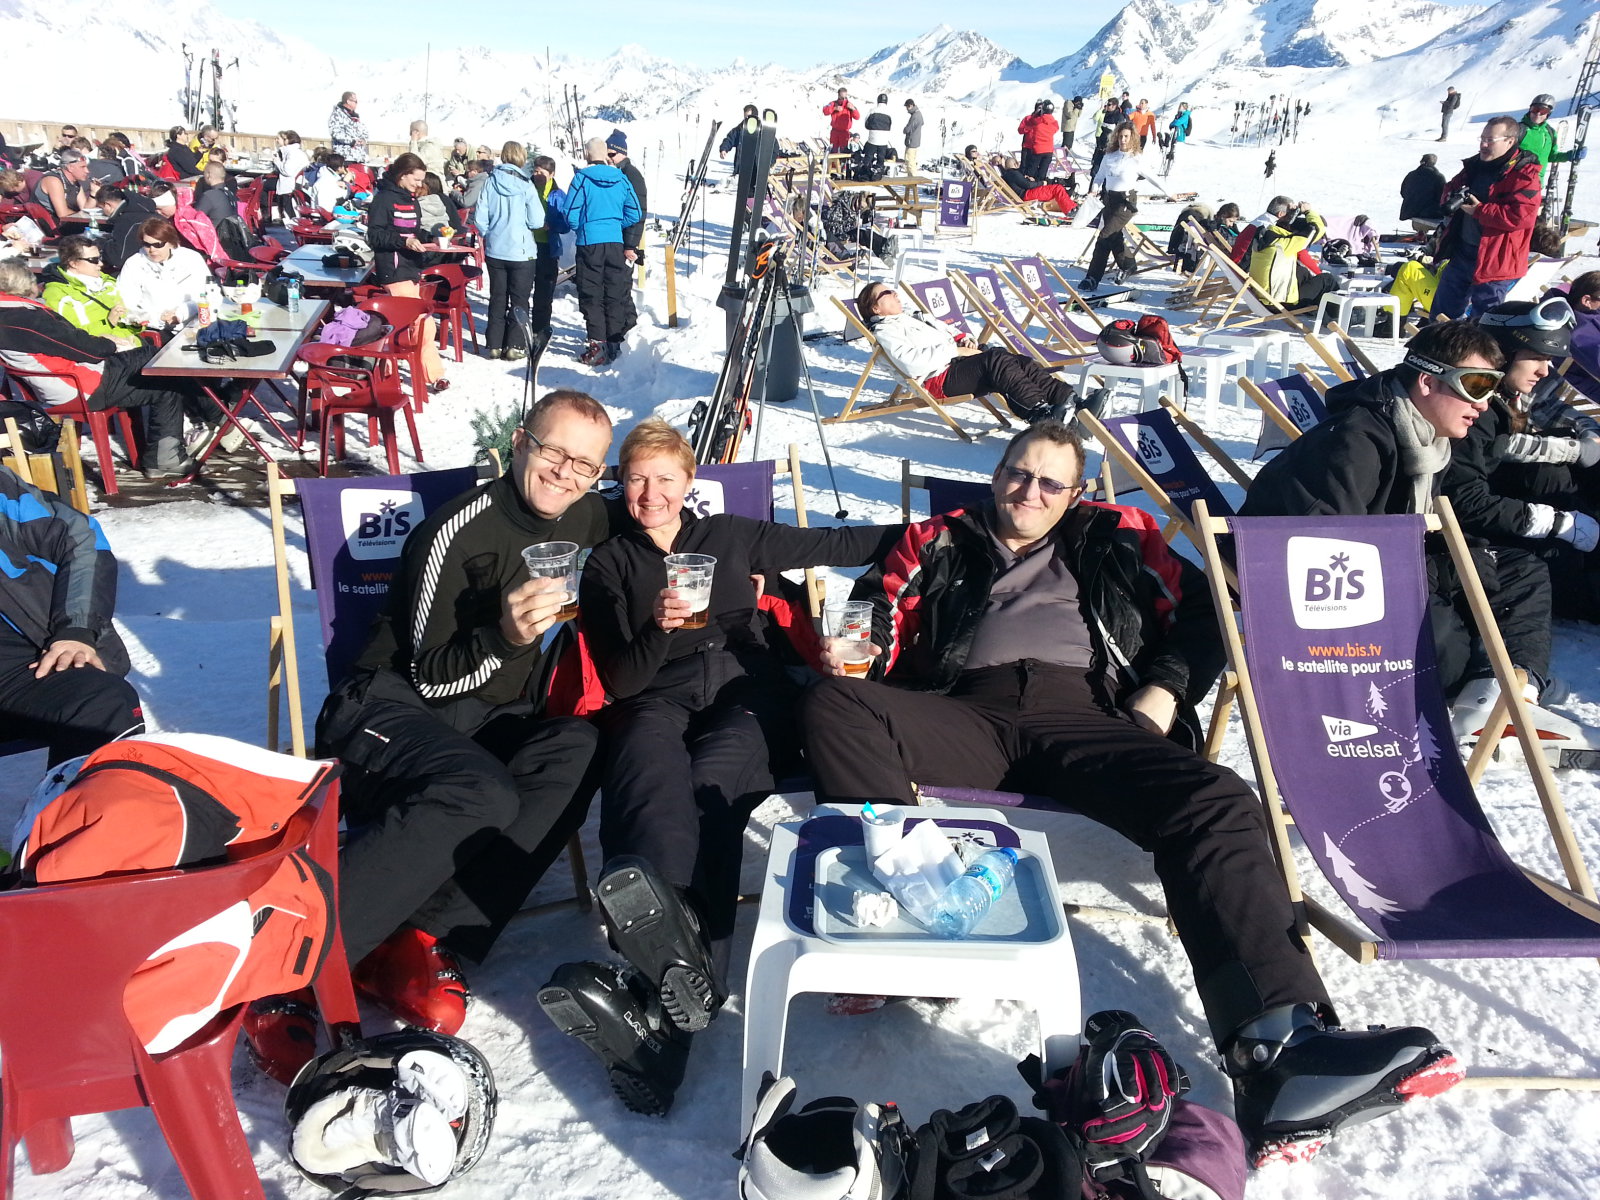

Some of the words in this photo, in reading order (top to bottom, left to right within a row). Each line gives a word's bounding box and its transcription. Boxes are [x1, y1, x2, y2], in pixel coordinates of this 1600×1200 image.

[1408, 354, 1444, 375] CARRERA
[358, 499, 411, 539] BiS
[358, 539, 396, 547] Télévisions
[1305, 551, 1365, 602] BiS
[339, 582, 349, 593] le
[1304, 604, 1347, 612] Télévisions
[1308, 643, 1382, 657] www.bis.tv
[1281, 656, 1294, 671] le
[1297, 658, 1349, 674] satellite
[1351, 661, 1381, 677] pour
[1384, 658, 1413, 671] tous
[1329, 720, 1352, 736] via
[1327, 740, 1402, 758] eutelsat
